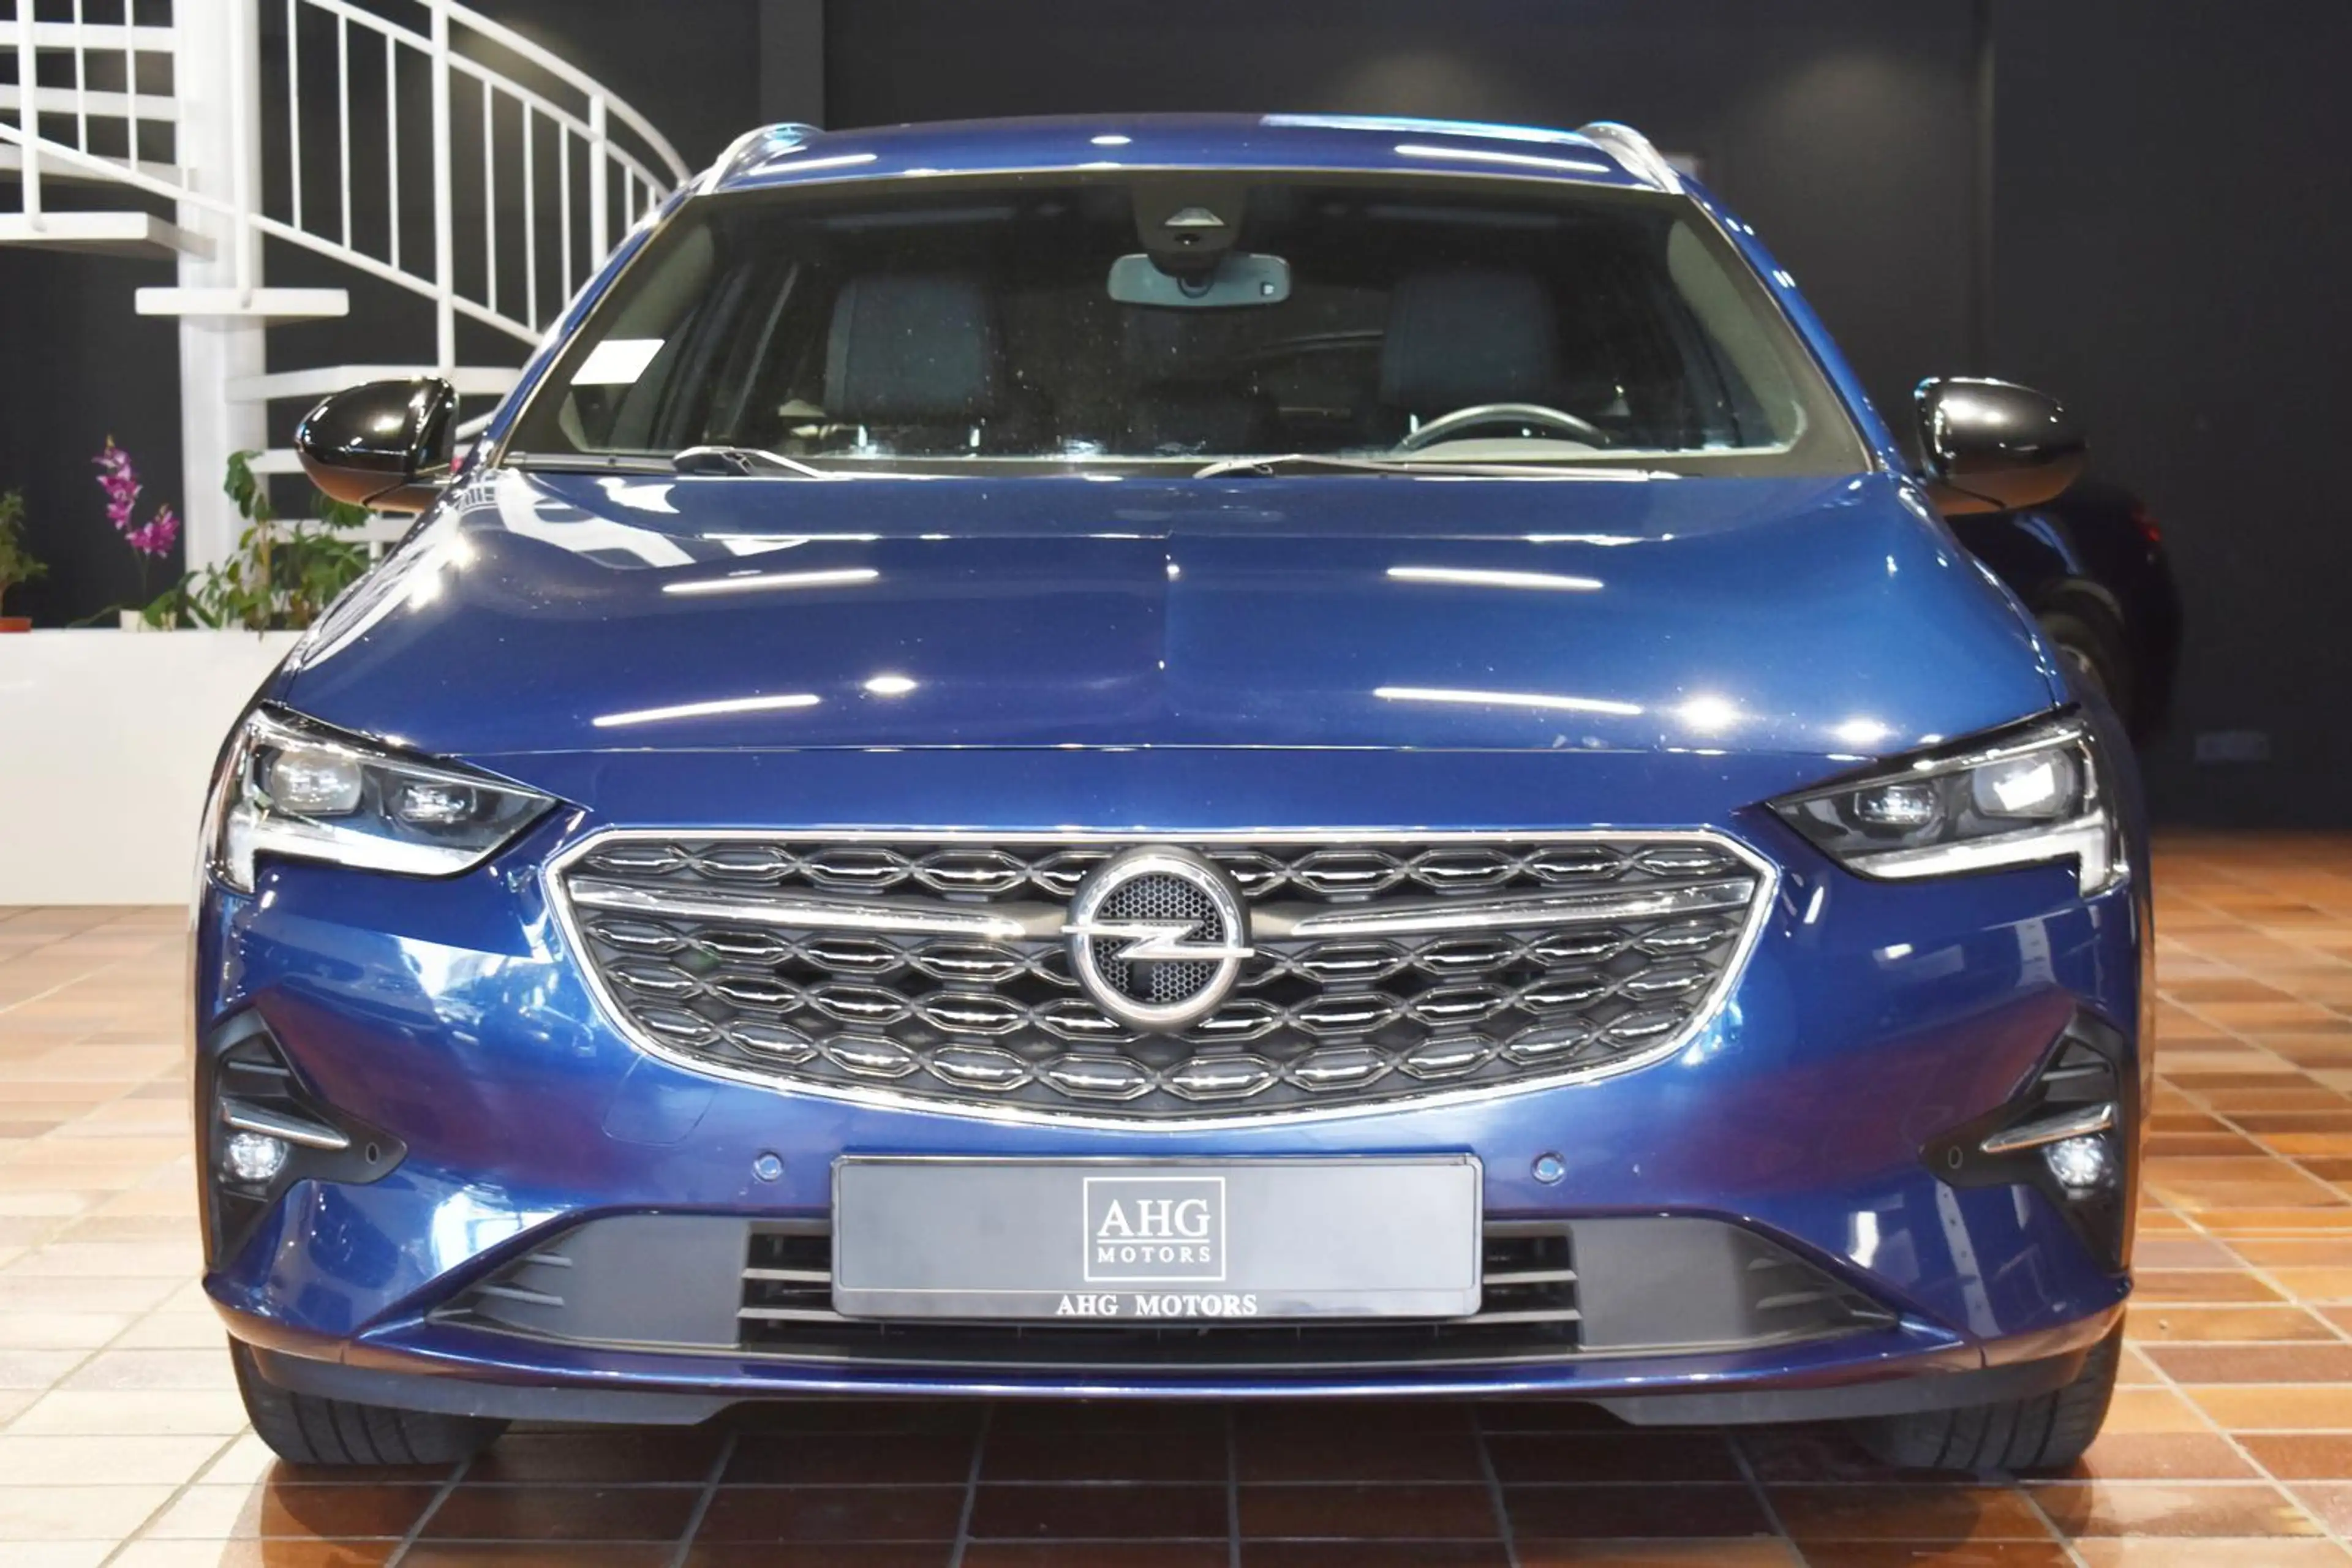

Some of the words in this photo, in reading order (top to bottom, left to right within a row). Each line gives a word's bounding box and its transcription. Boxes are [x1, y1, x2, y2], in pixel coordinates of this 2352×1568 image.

[1097, 1199, 1211, 1237] AHG
[1097, 1246, 1211, 1264] MOTORS
[1057, 1294, 1119, 1316] AHG
[1135, 1294, 1258, 1317] MOTORS
